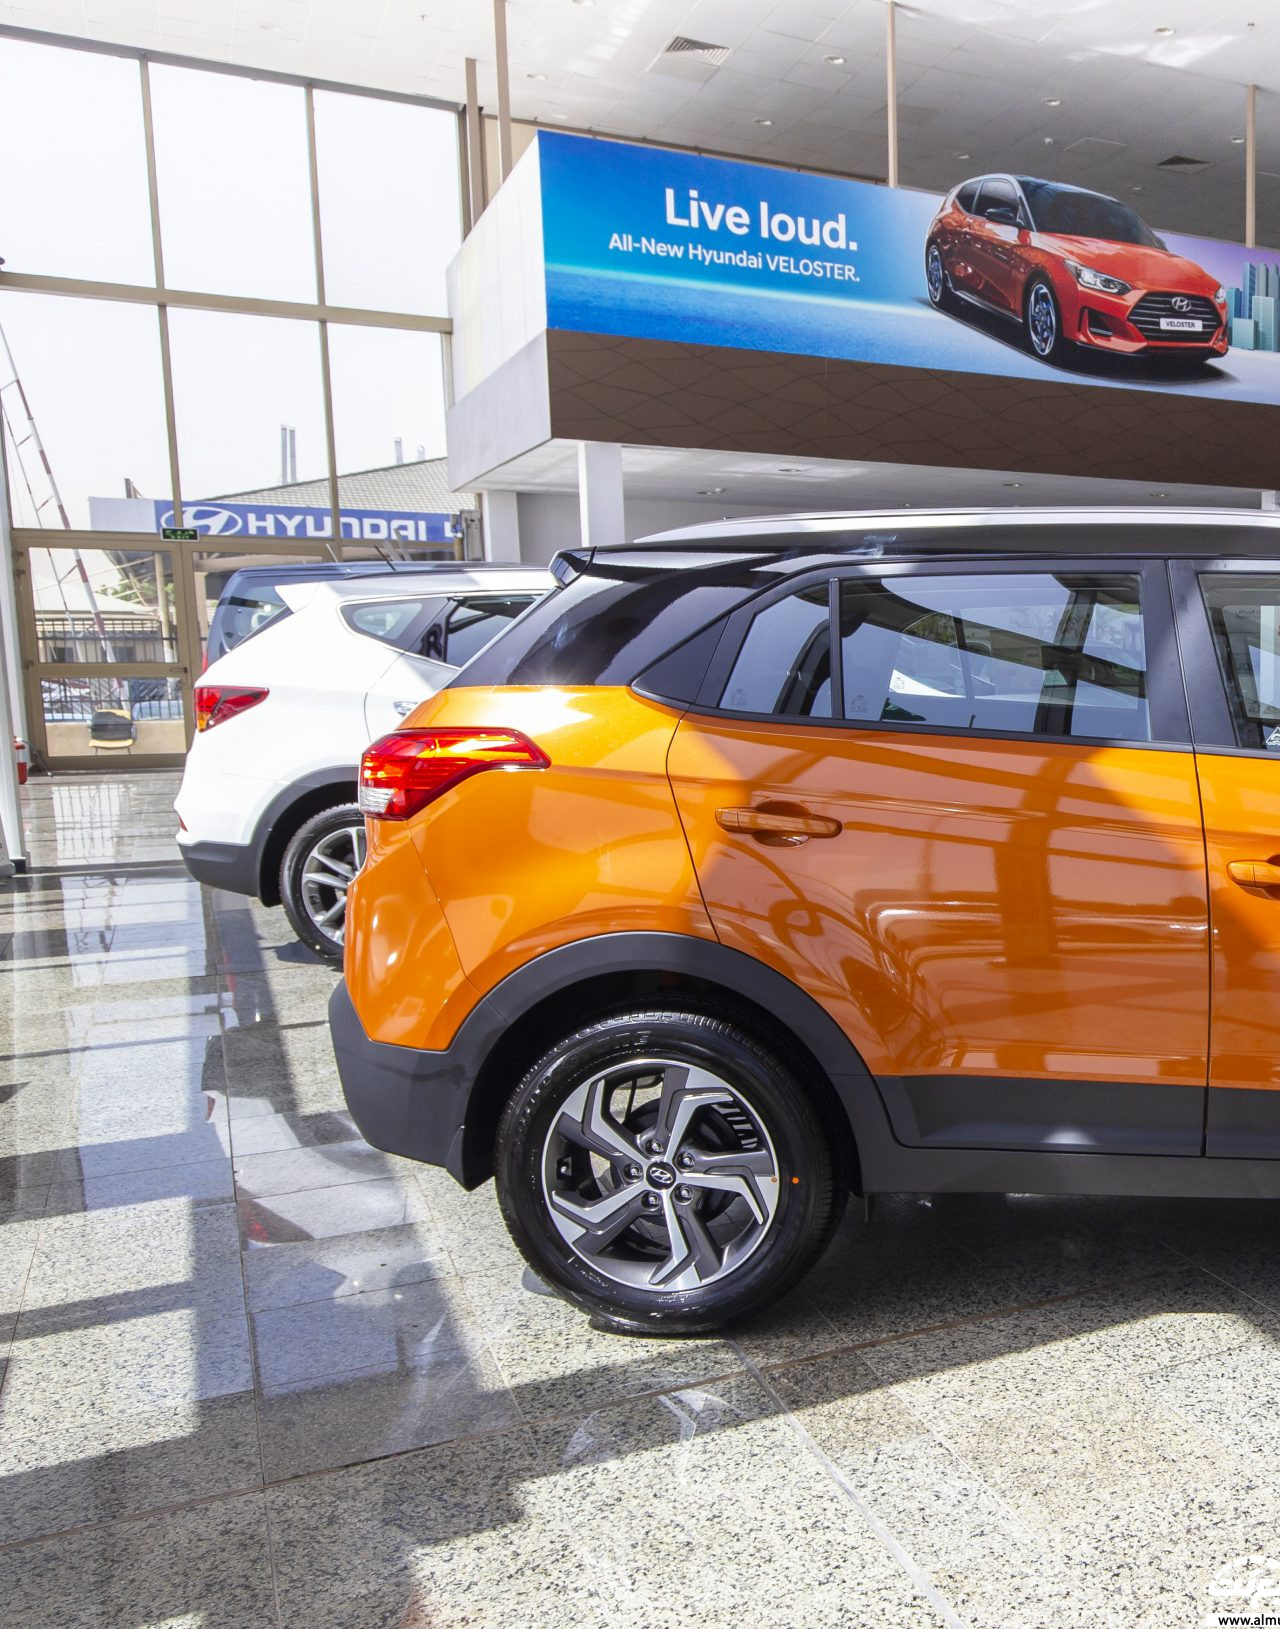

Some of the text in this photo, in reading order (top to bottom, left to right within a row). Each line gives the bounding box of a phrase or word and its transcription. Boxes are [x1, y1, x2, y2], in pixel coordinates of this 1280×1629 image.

[665, 187, 858, 251] Live loud.
[608, 232, 861, 283] All-New Hyundai VELOSTER.
[1165, 320, 1196, 329] VELOSTER
